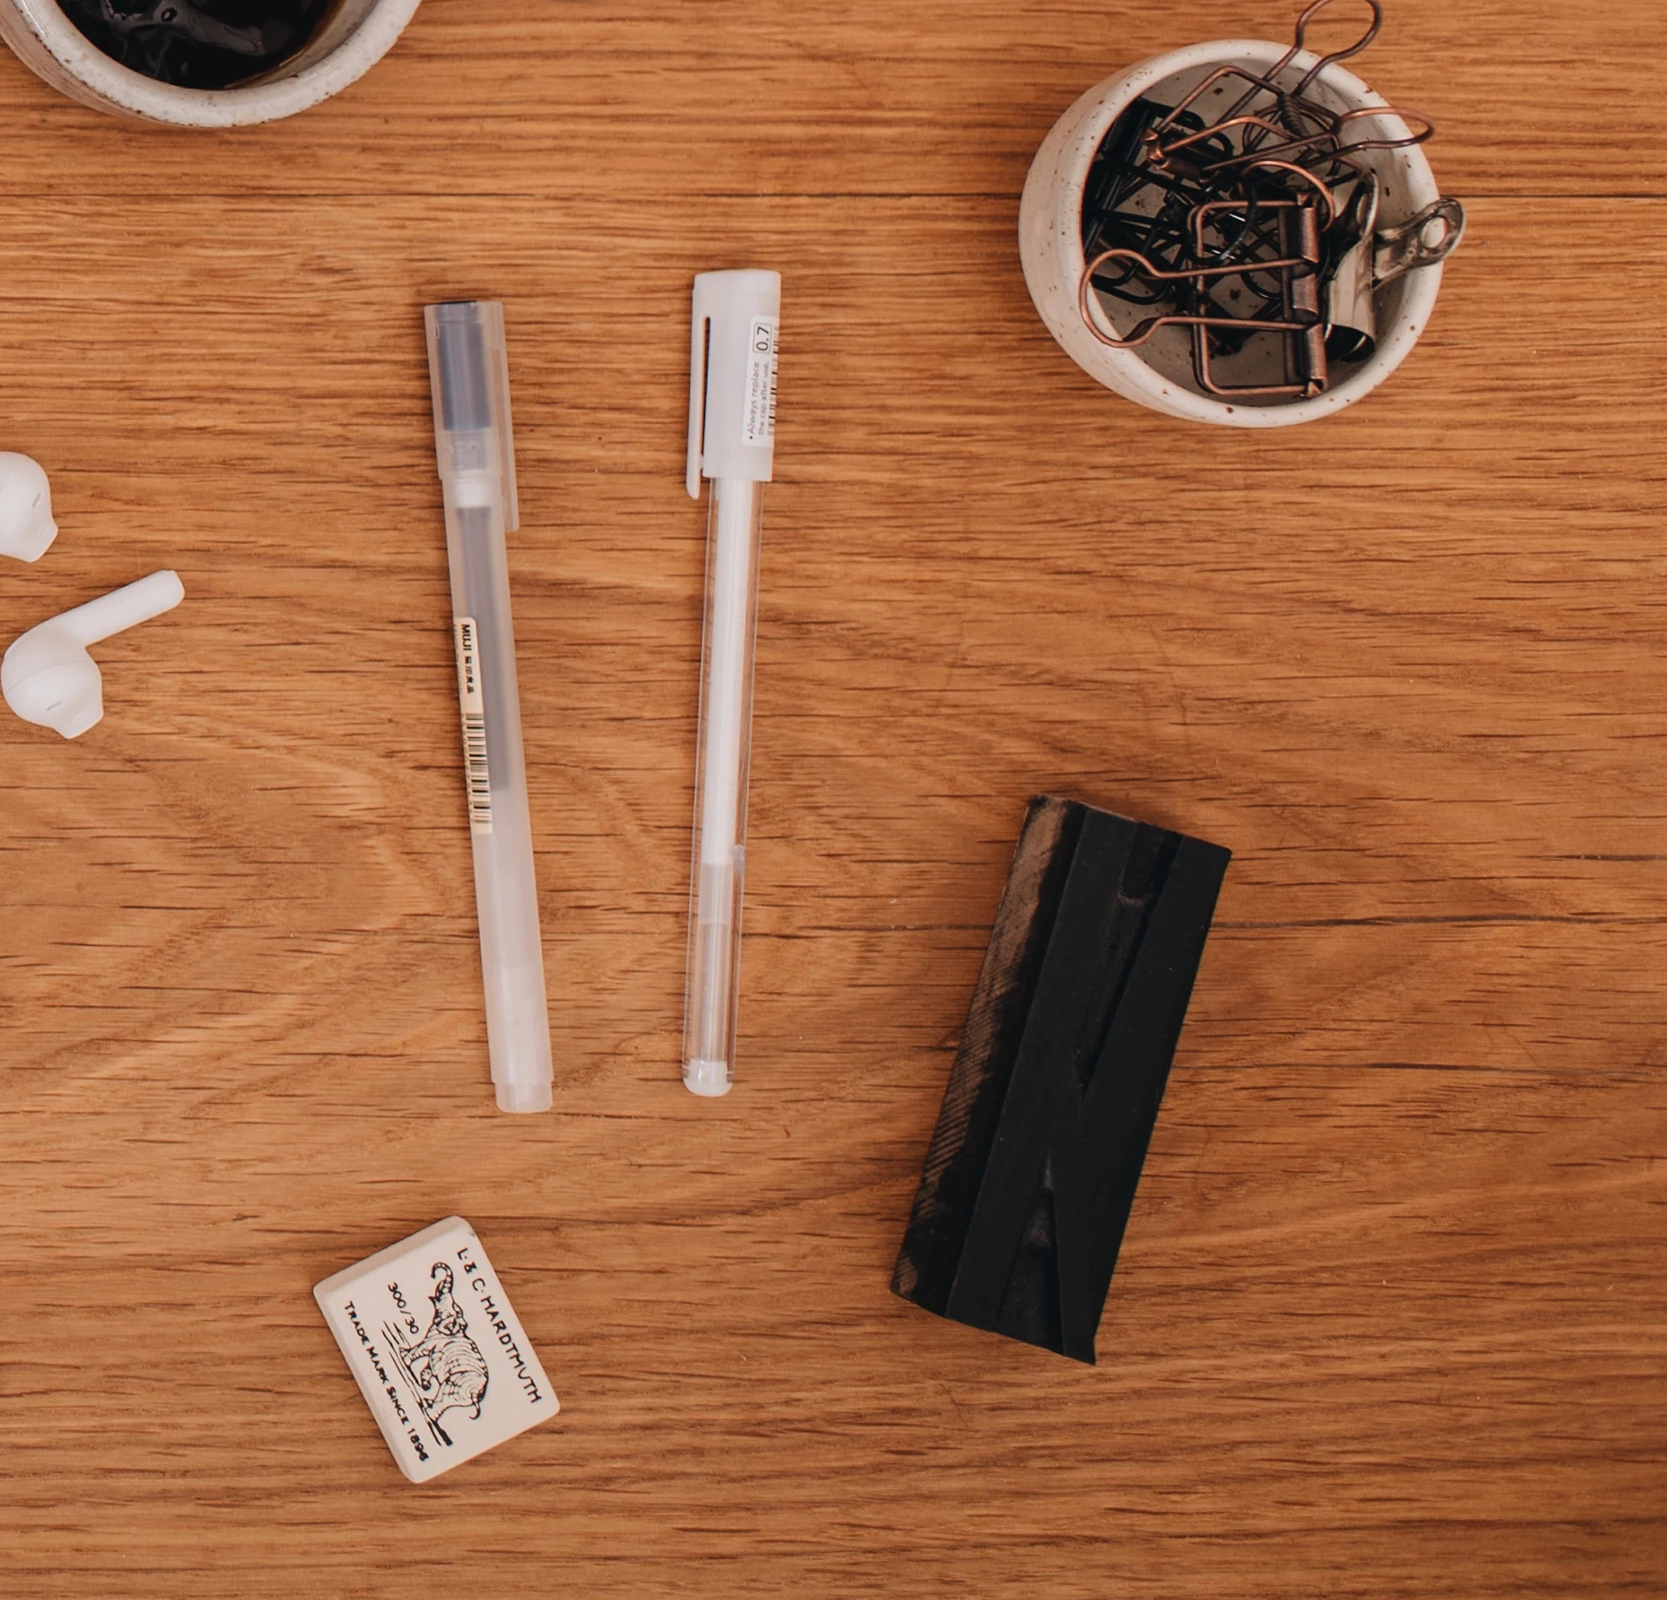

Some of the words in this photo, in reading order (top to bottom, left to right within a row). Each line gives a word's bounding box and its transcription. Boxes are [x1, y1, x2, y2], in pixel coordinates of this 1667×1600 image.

[755, 326, 770, 352] 0.7
[750, 361, 760, 397] replace
[747, 400, 759, 434] Always
[461, 623, 473, 652] MUJI
[387, 1282, 420, 1335] 300/30
[480, 1295, 543, 1404] HARDTMUTH
